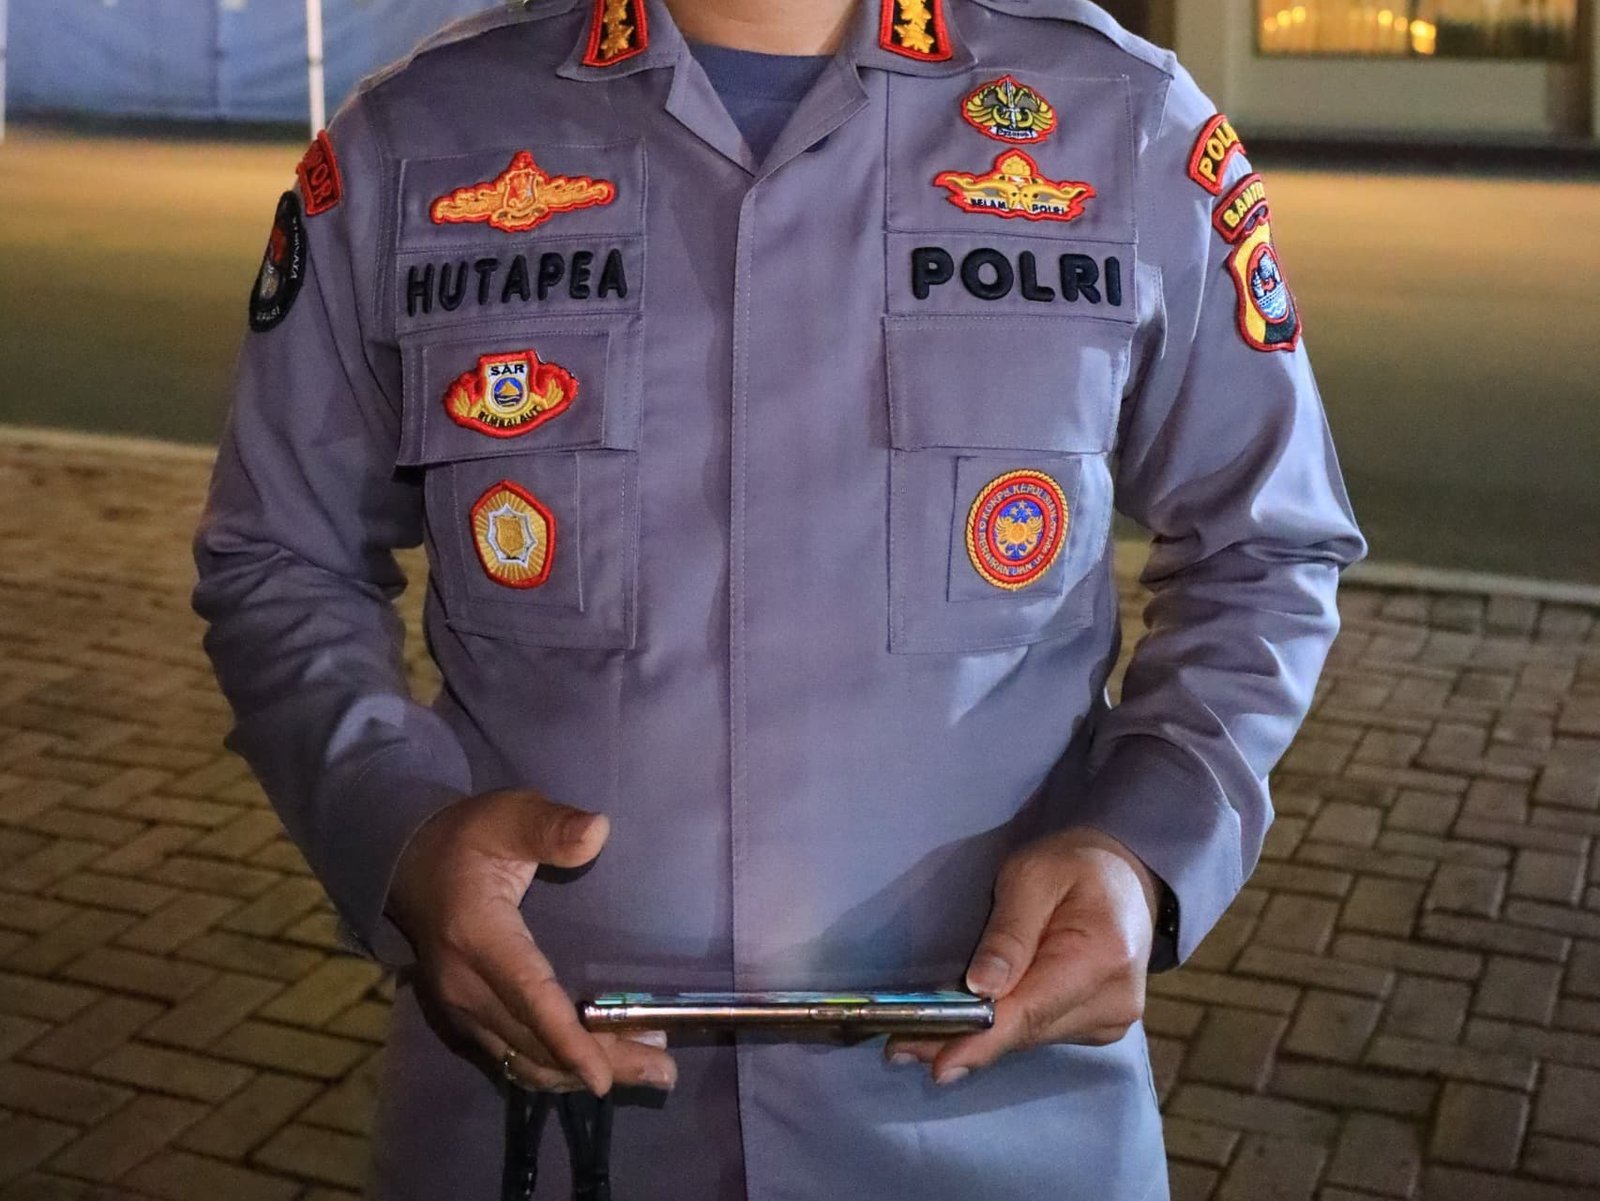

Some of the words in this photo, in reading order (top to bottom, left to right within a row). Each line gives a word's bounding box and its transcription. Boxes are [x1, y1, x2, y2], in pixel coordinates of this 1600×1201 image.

[407, 248, 627, 317] HUTAPEA
[912, 247, 1121, 306] POLRI
[490, 363, 525, 376] SAR
